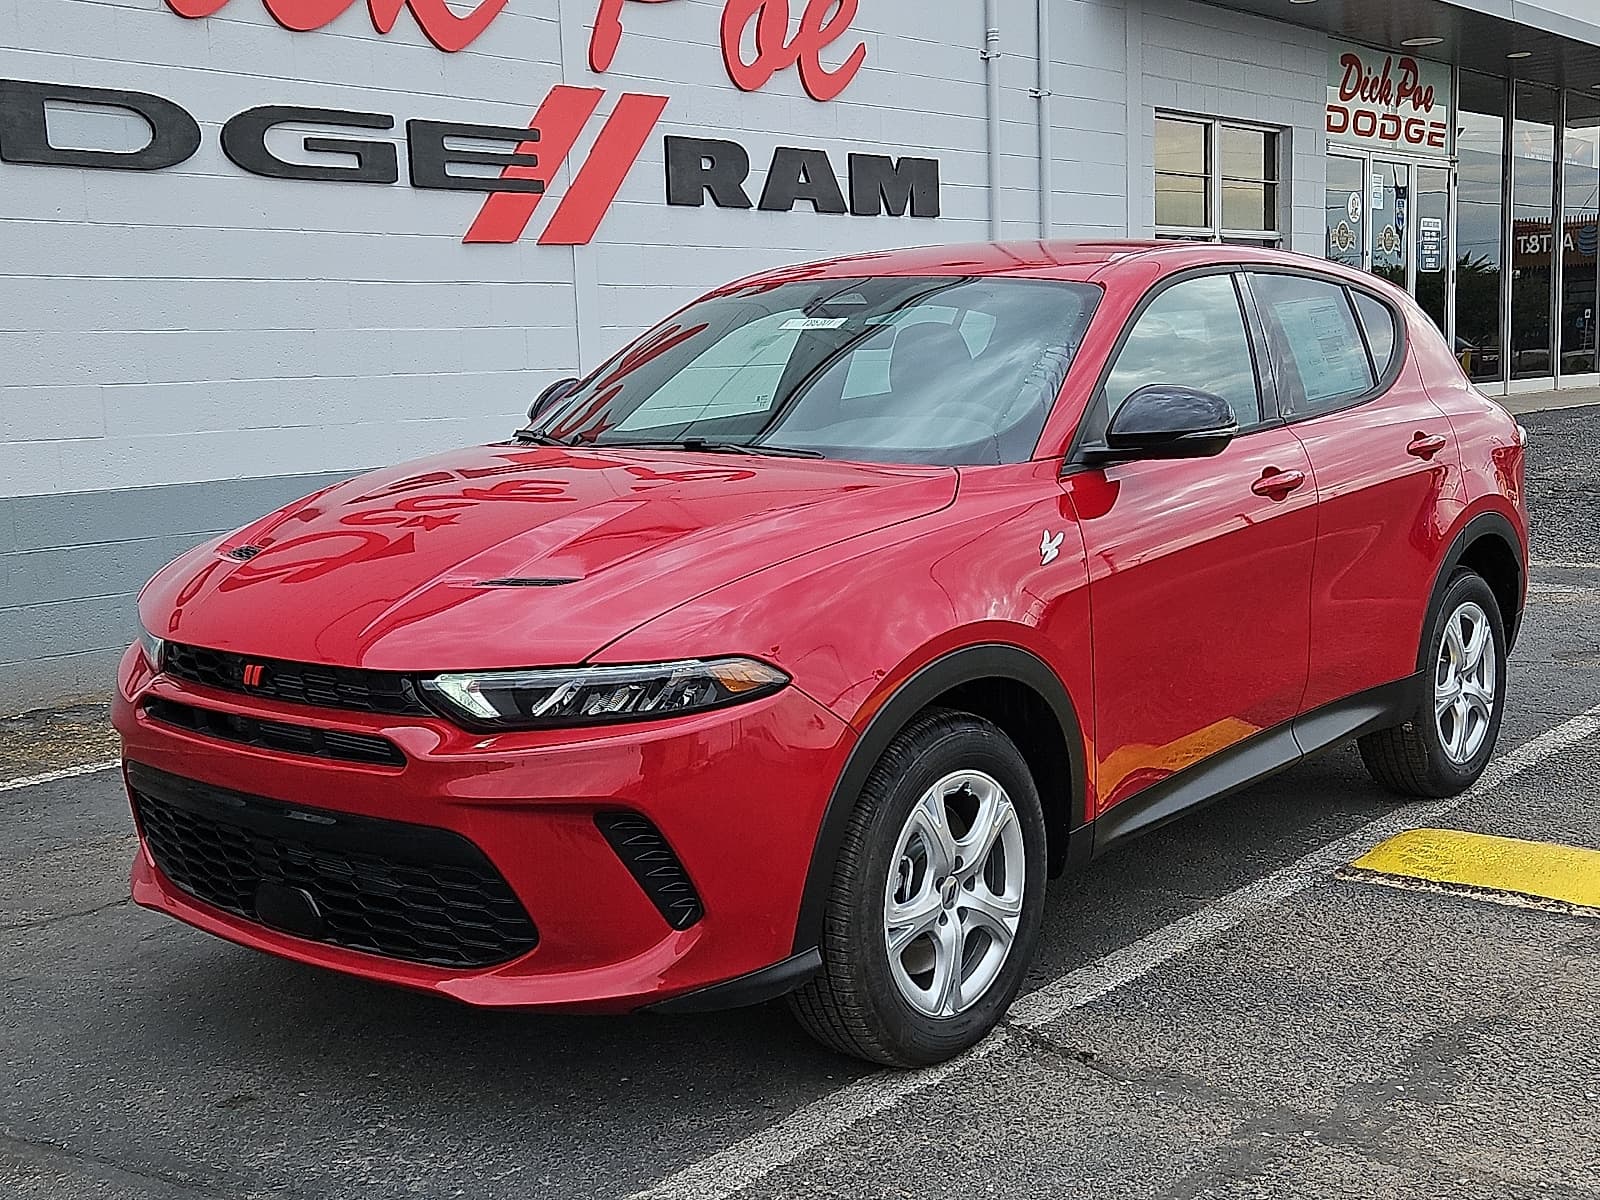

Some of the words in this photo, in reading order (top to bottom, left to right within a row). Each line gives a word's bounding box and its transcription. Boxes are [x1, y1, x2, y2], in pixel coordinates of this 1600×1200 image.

[1339, 53, 1393, 106] Dick
[1396, 57, 1434, 113] Poe
[1326, 104, 1447, 148] DODGE
[664, 135, 940, 218] RAM
